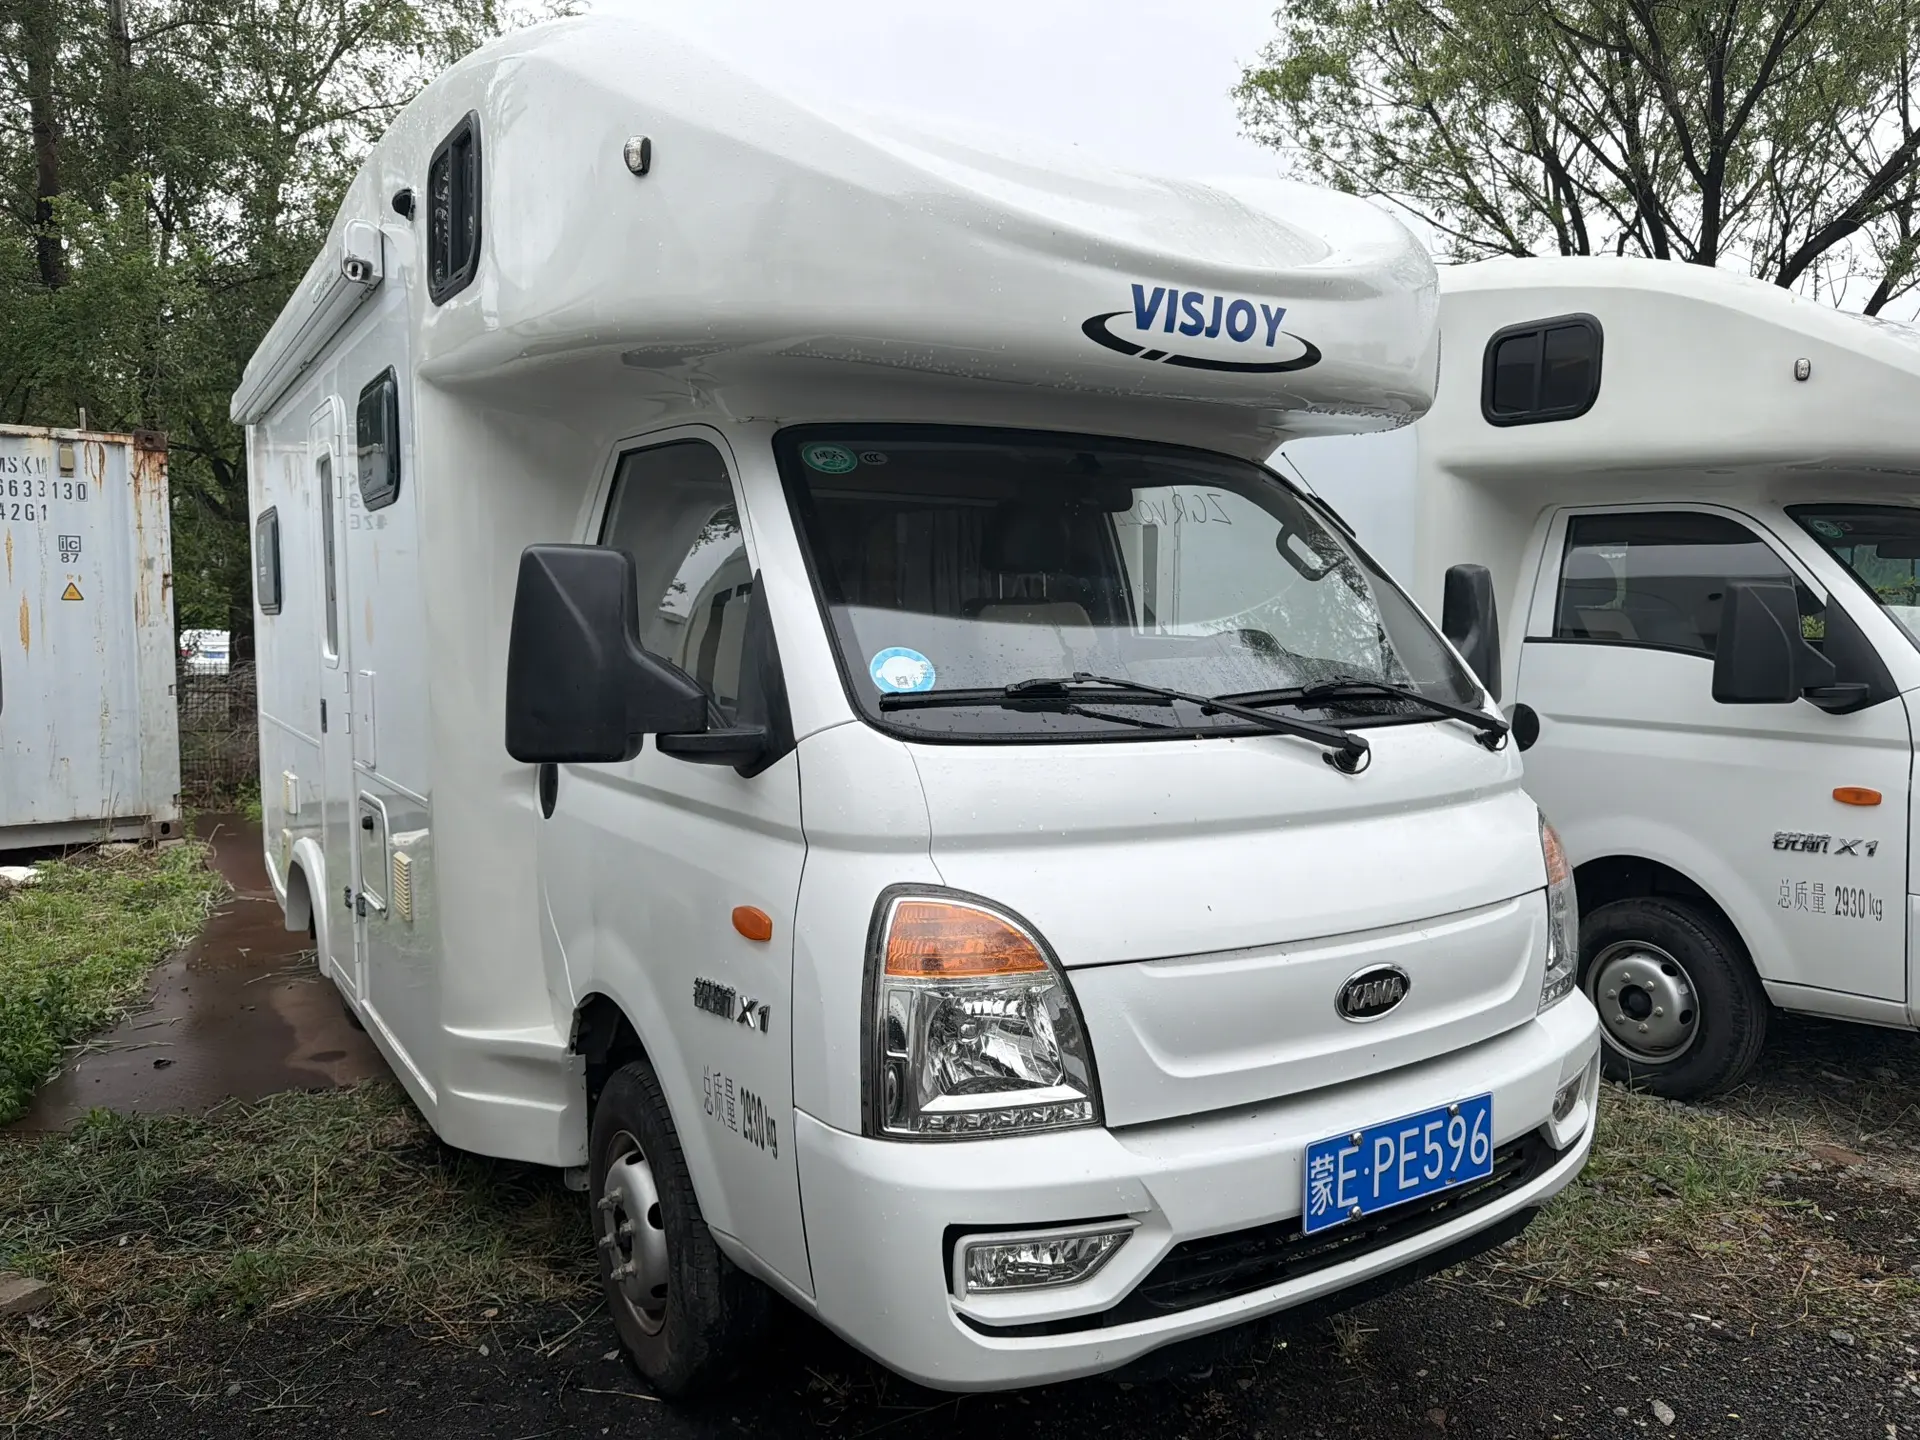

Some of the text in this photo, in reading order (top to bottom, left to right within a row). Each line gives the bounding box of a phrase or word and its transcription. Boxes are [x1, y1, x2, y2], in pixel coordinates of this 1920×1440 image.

[1131, 283, 1287, 347] VISJOY
[61, 553, 79, 563] 87
[1834, 838, 1879, 857] X1
[1778, 879, 1826, 914] 总质量
[1347, 976, 1403, 1012] KAMA
[736, 995, 771, 1034] X1
[703, 1064, 738, 1133] 总质量
